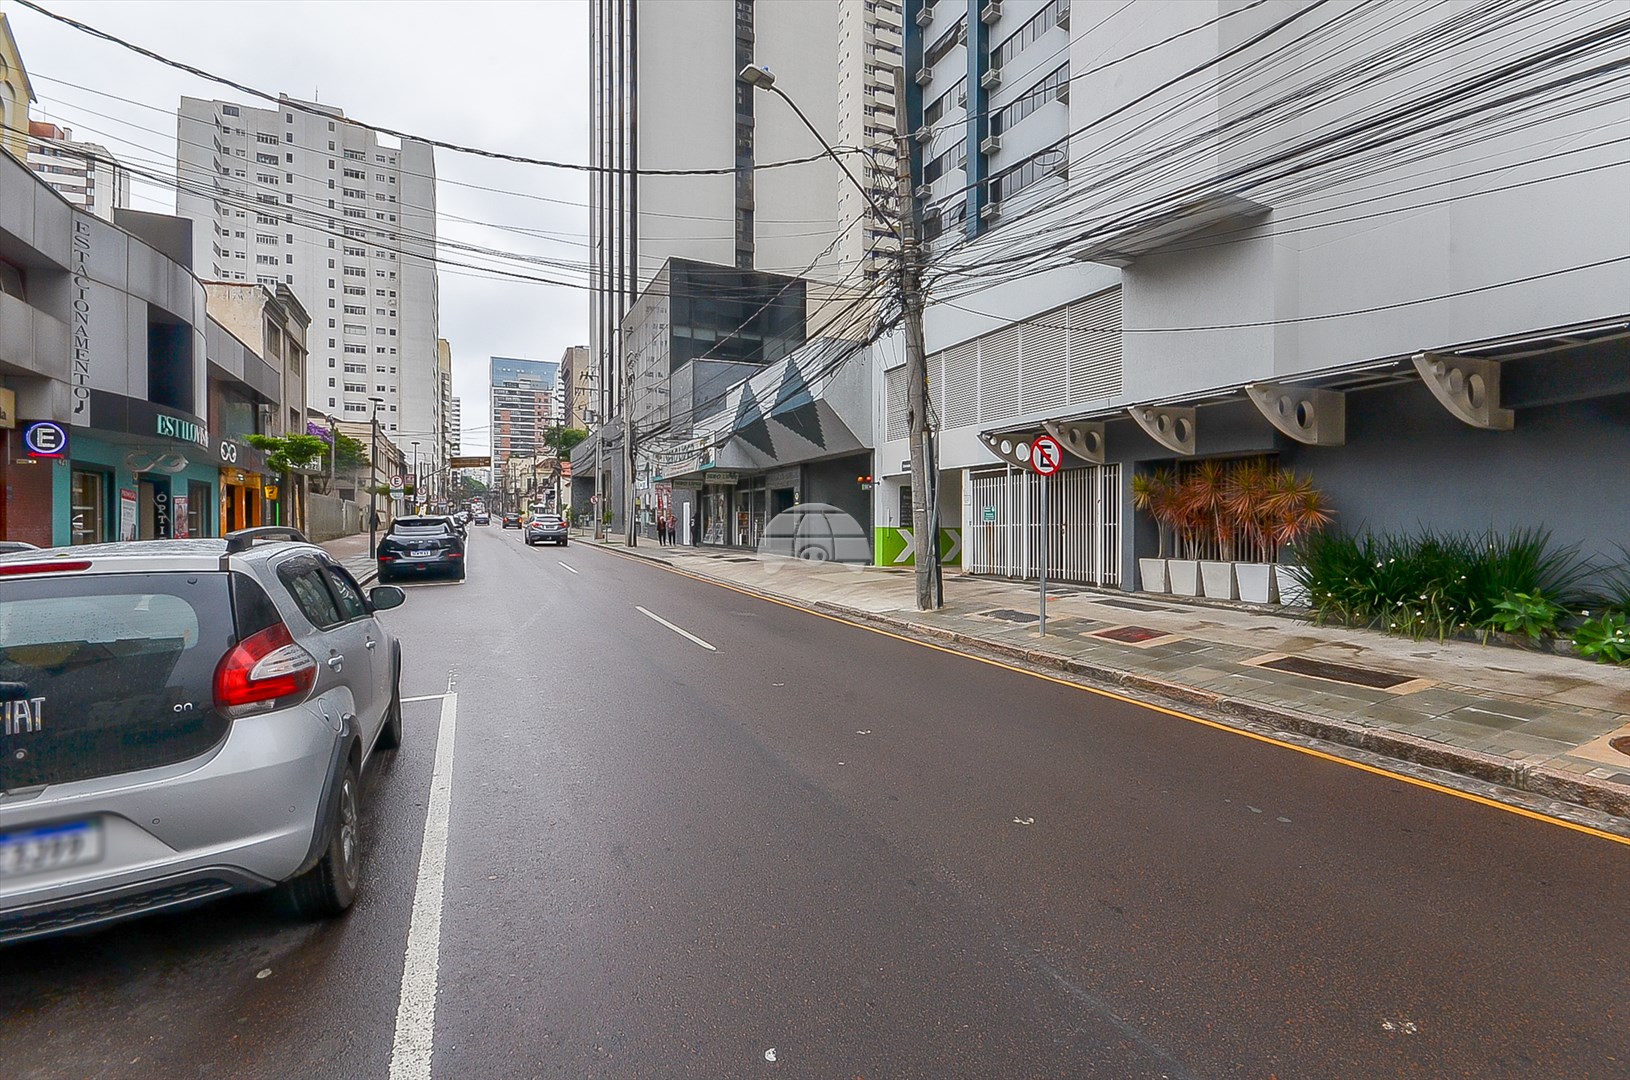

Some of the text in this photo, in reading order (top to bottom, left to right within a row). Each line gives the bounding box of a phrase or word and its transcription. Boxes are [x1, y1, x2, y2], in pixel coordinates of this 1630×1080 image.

[73, 219, 90, 399] ESTACIONAMENTO
[36, 427, 56, 448] E
[1040, 444, 1052, 467] E
[0, 697, 46, 735] IAT
[173, 702, 193, 713] on
